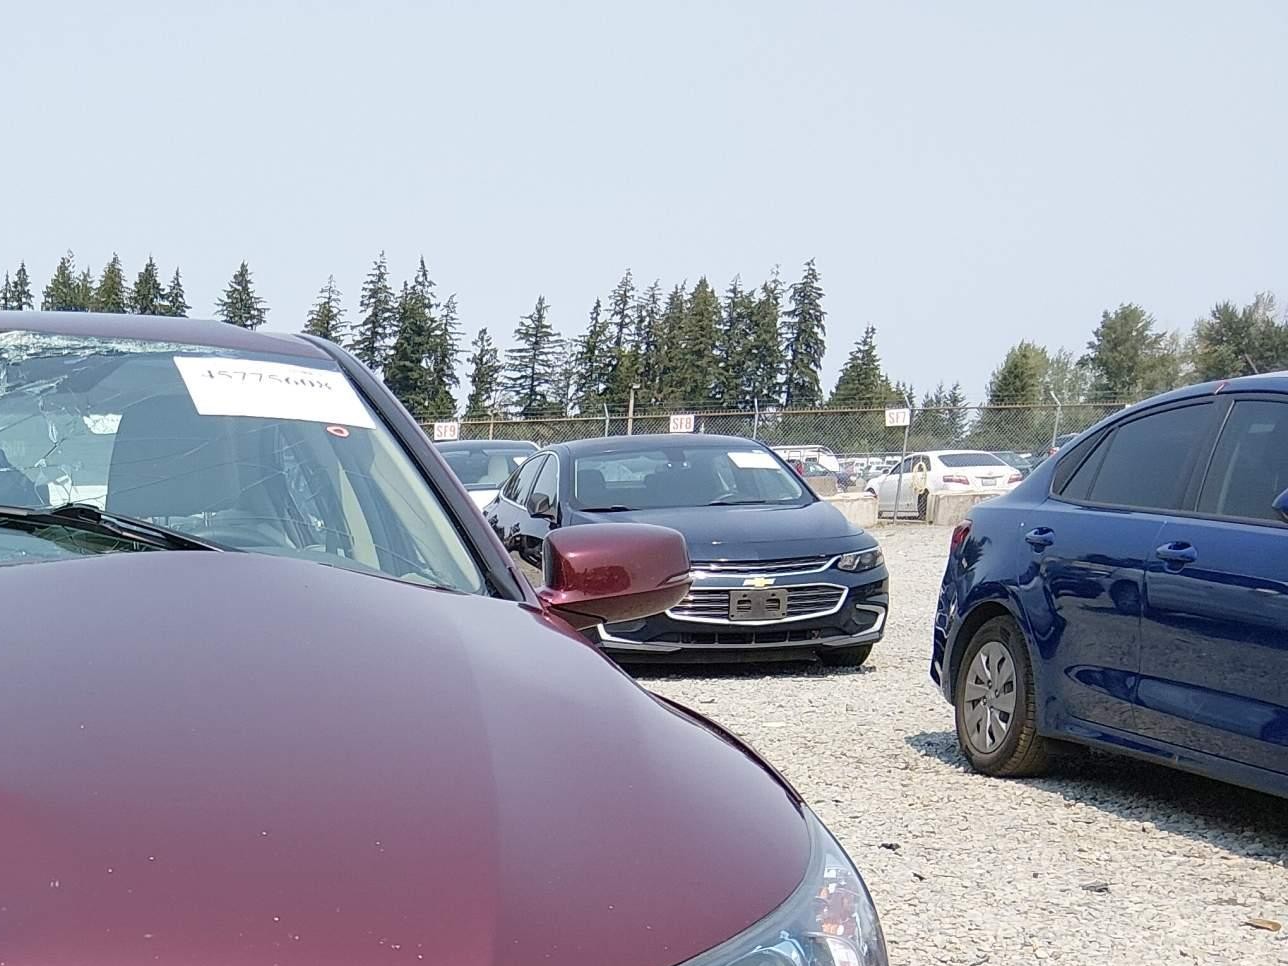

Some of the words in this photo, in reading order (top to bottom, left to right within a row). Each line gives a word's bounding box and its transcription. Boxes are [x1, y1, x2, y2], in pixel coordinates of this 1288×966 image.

[672, 417, 692, 430] SF8
[888, 411, 906, 424] SF7
[436, 424, 456, 437] SF9
